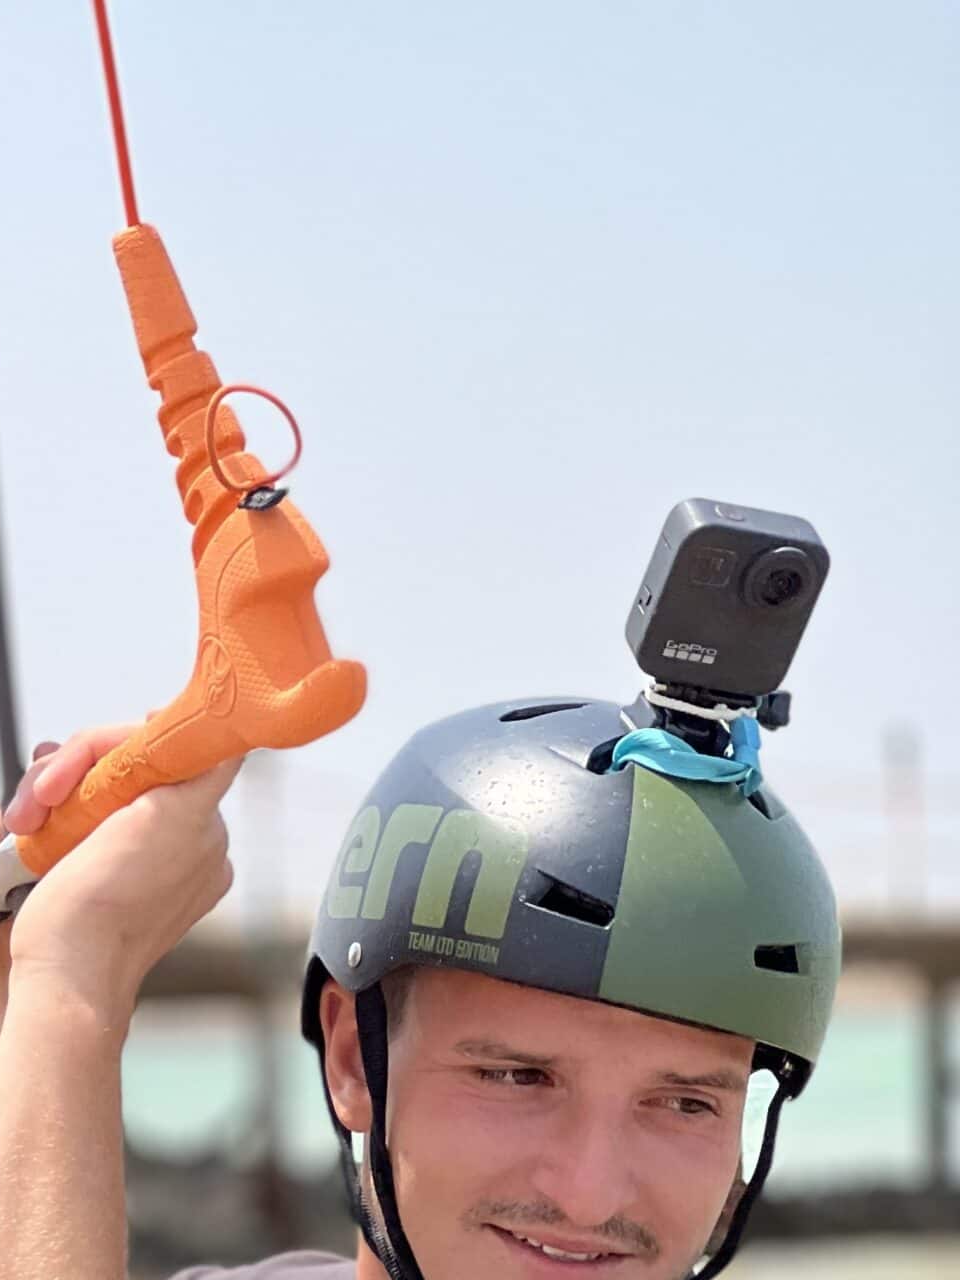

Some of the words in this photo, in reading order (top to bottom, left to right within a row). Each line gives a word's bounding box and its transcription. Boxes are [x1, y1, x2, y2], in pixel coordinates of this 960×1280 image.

[665, 639, 718, 657] GoPro
[407, 931, 436, 954] TEAM
[436, 936, 455, 957] LTD
[455, 939, 501, 965] EDITION
